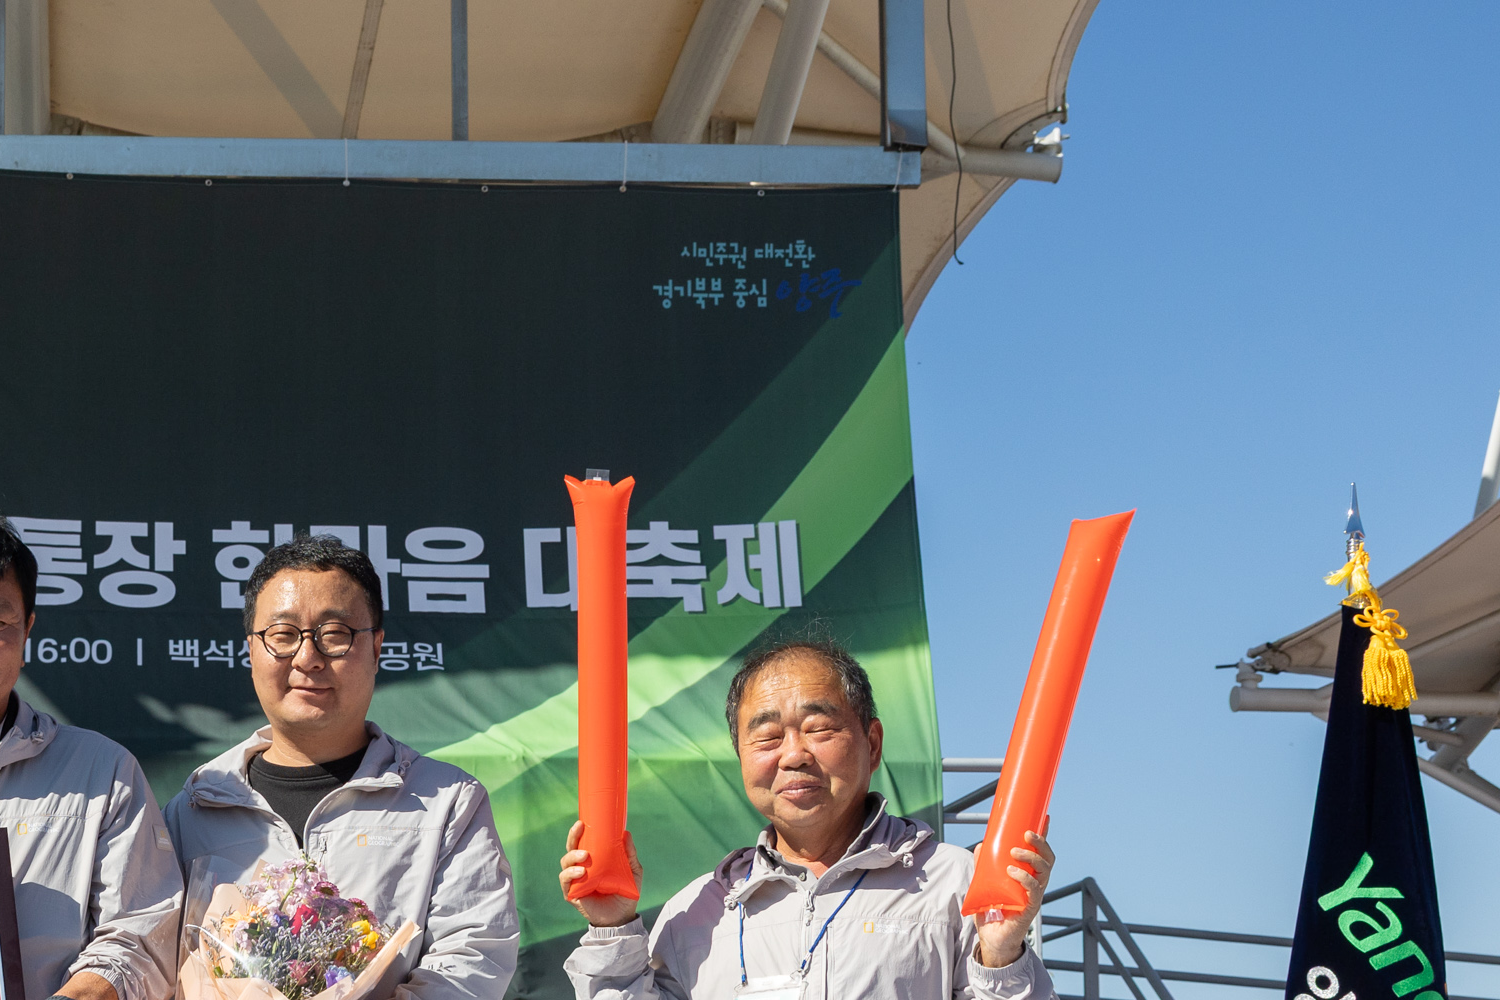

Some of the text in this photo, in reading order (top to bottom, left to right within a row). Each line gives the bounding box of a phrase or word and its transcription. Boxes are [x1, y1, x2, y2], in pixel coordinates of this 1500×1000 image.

[681, 240, 816, 269] 시민주권 대전환
[653, 267, 862, 319] 경기북부 중심 양주
[523, 519, 803, 612] 대축제
